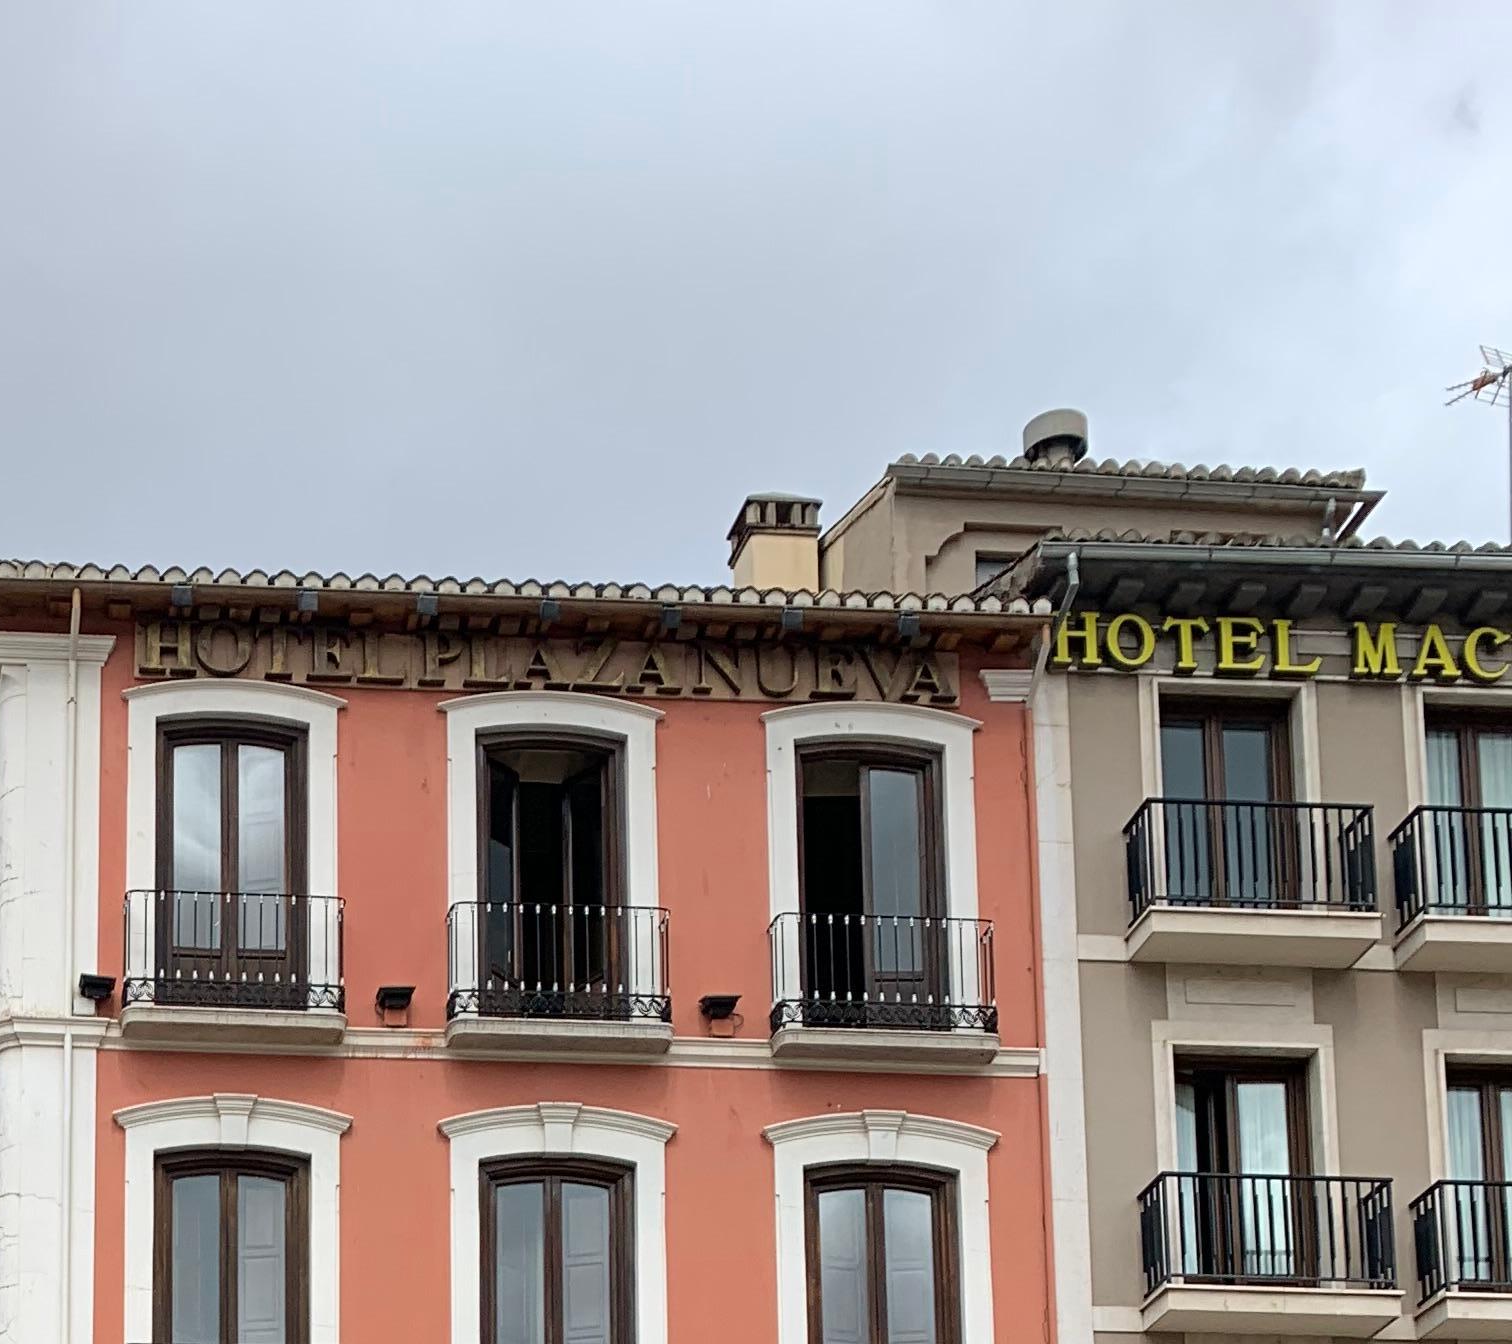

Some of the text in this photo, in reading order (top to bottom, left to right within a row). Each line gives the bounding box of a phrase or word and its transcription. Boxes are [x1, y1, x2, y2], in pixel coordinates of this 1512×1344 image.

[138, 620, 958, 704] HOTEL PLAZA NUEVA
[1051, 610, 1512, 683] HOTEL MAC
